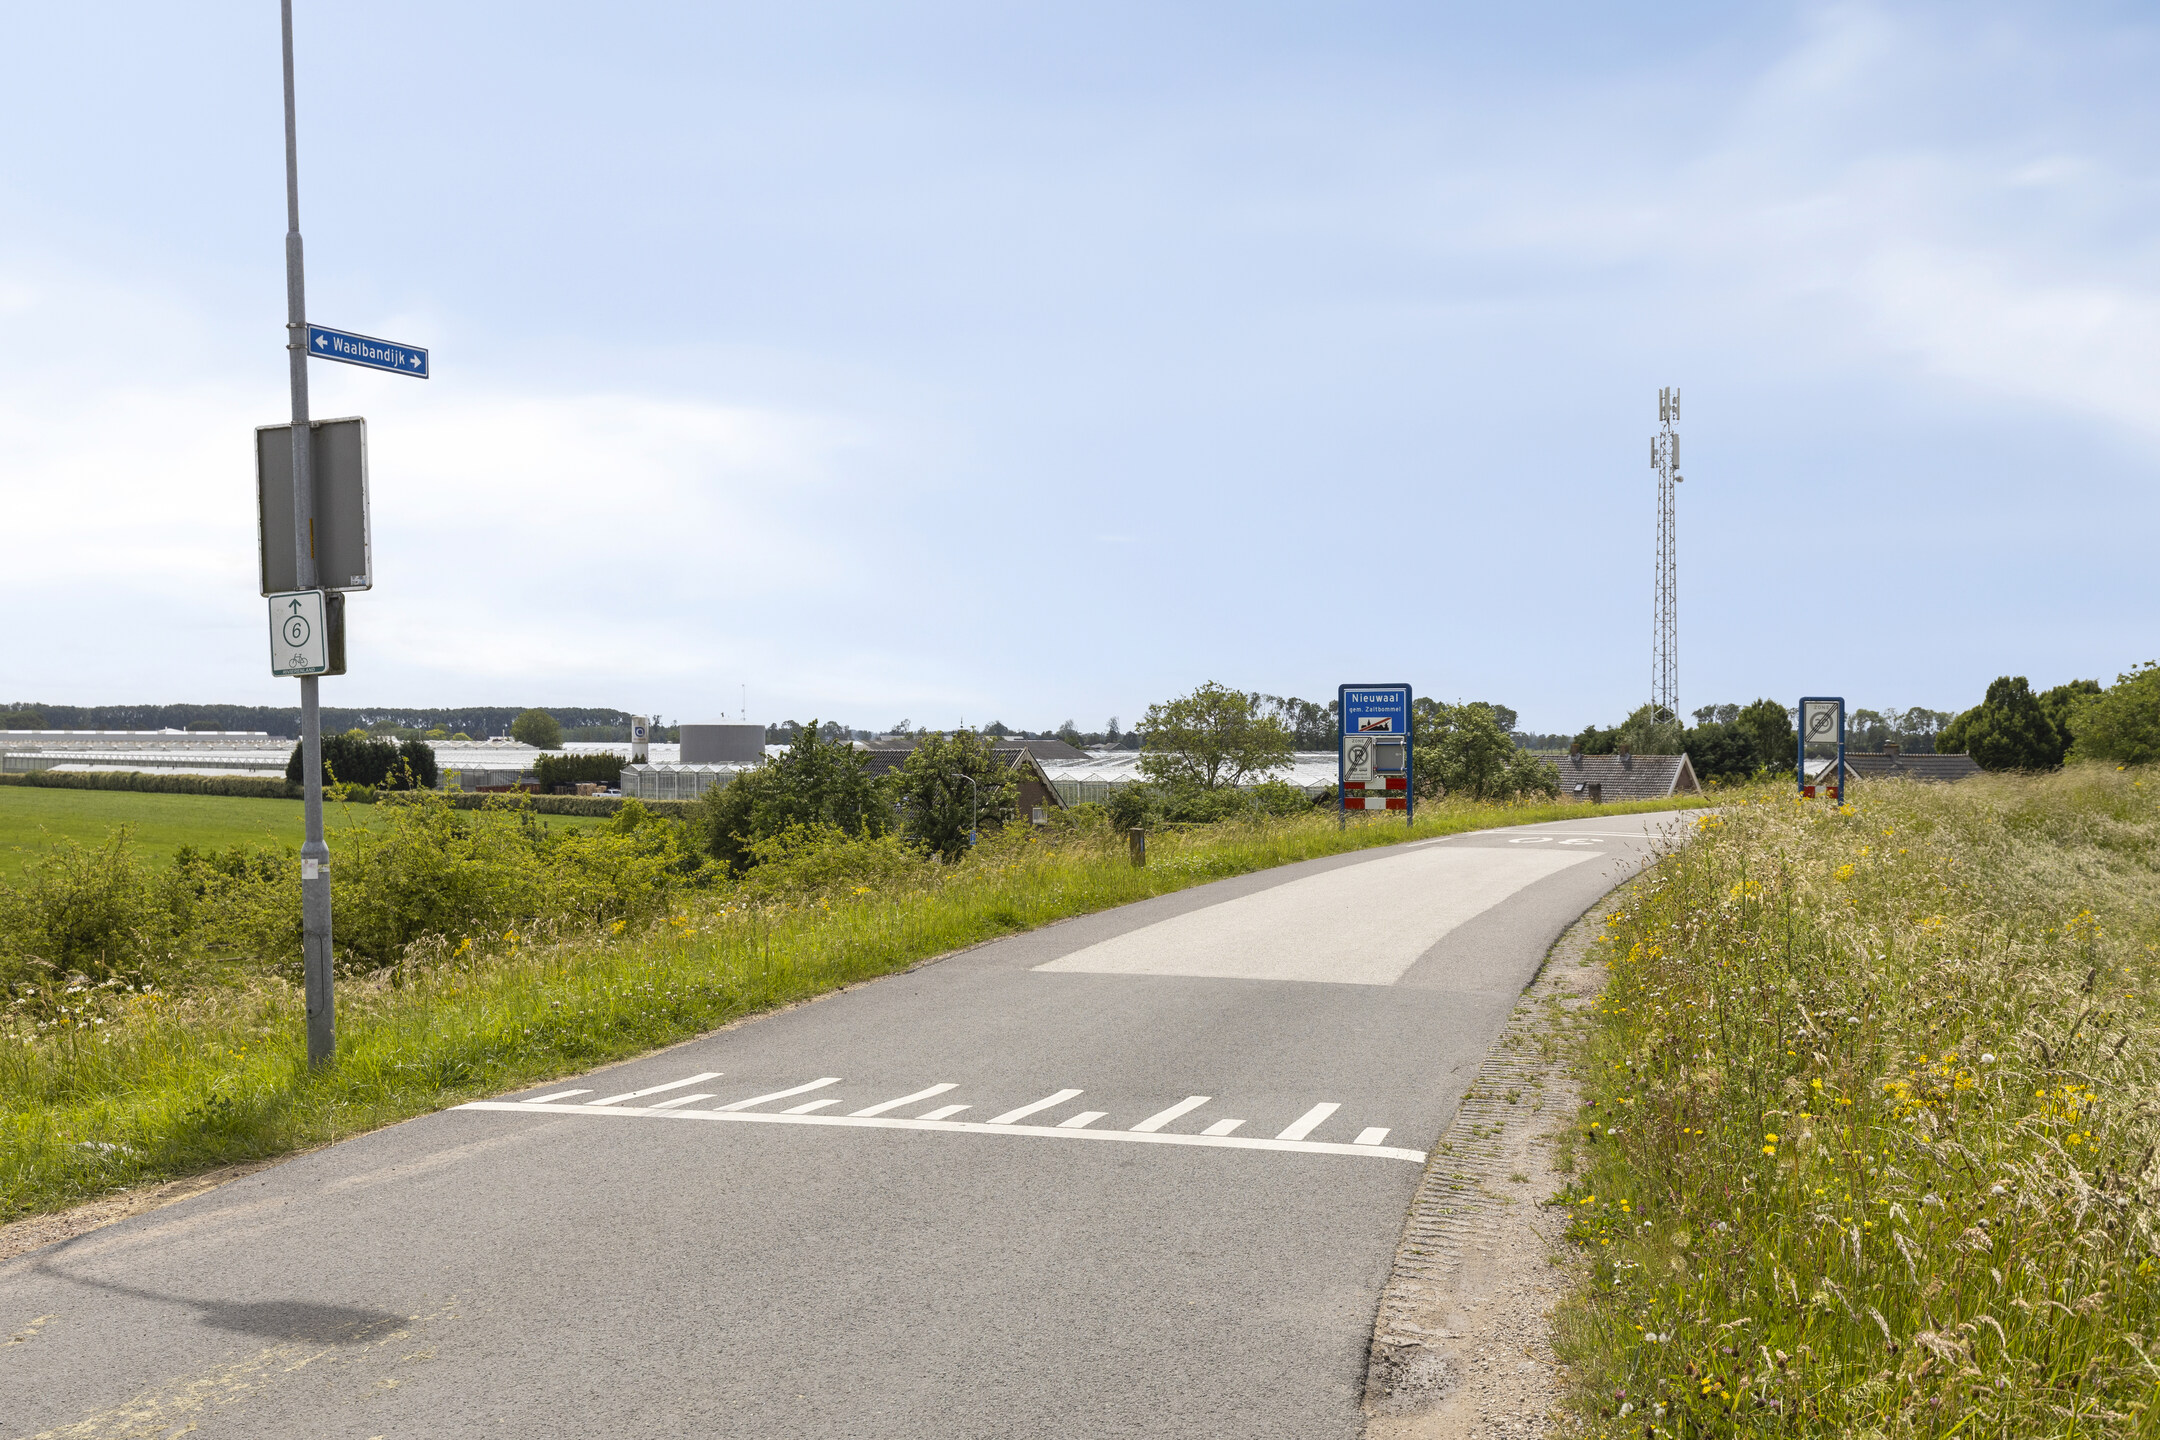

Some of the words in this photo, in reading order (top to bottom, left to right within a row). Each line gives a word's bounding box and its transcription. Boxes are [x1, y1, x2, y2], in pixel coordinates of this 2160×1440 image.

[333, 337, 405, 367] Waalbandijk
[292, 622, 302, 639] 6
[1352, 693, 1399, 703] Nieuwaal
[1365, 705, 1402, 713] Zaltbommel
